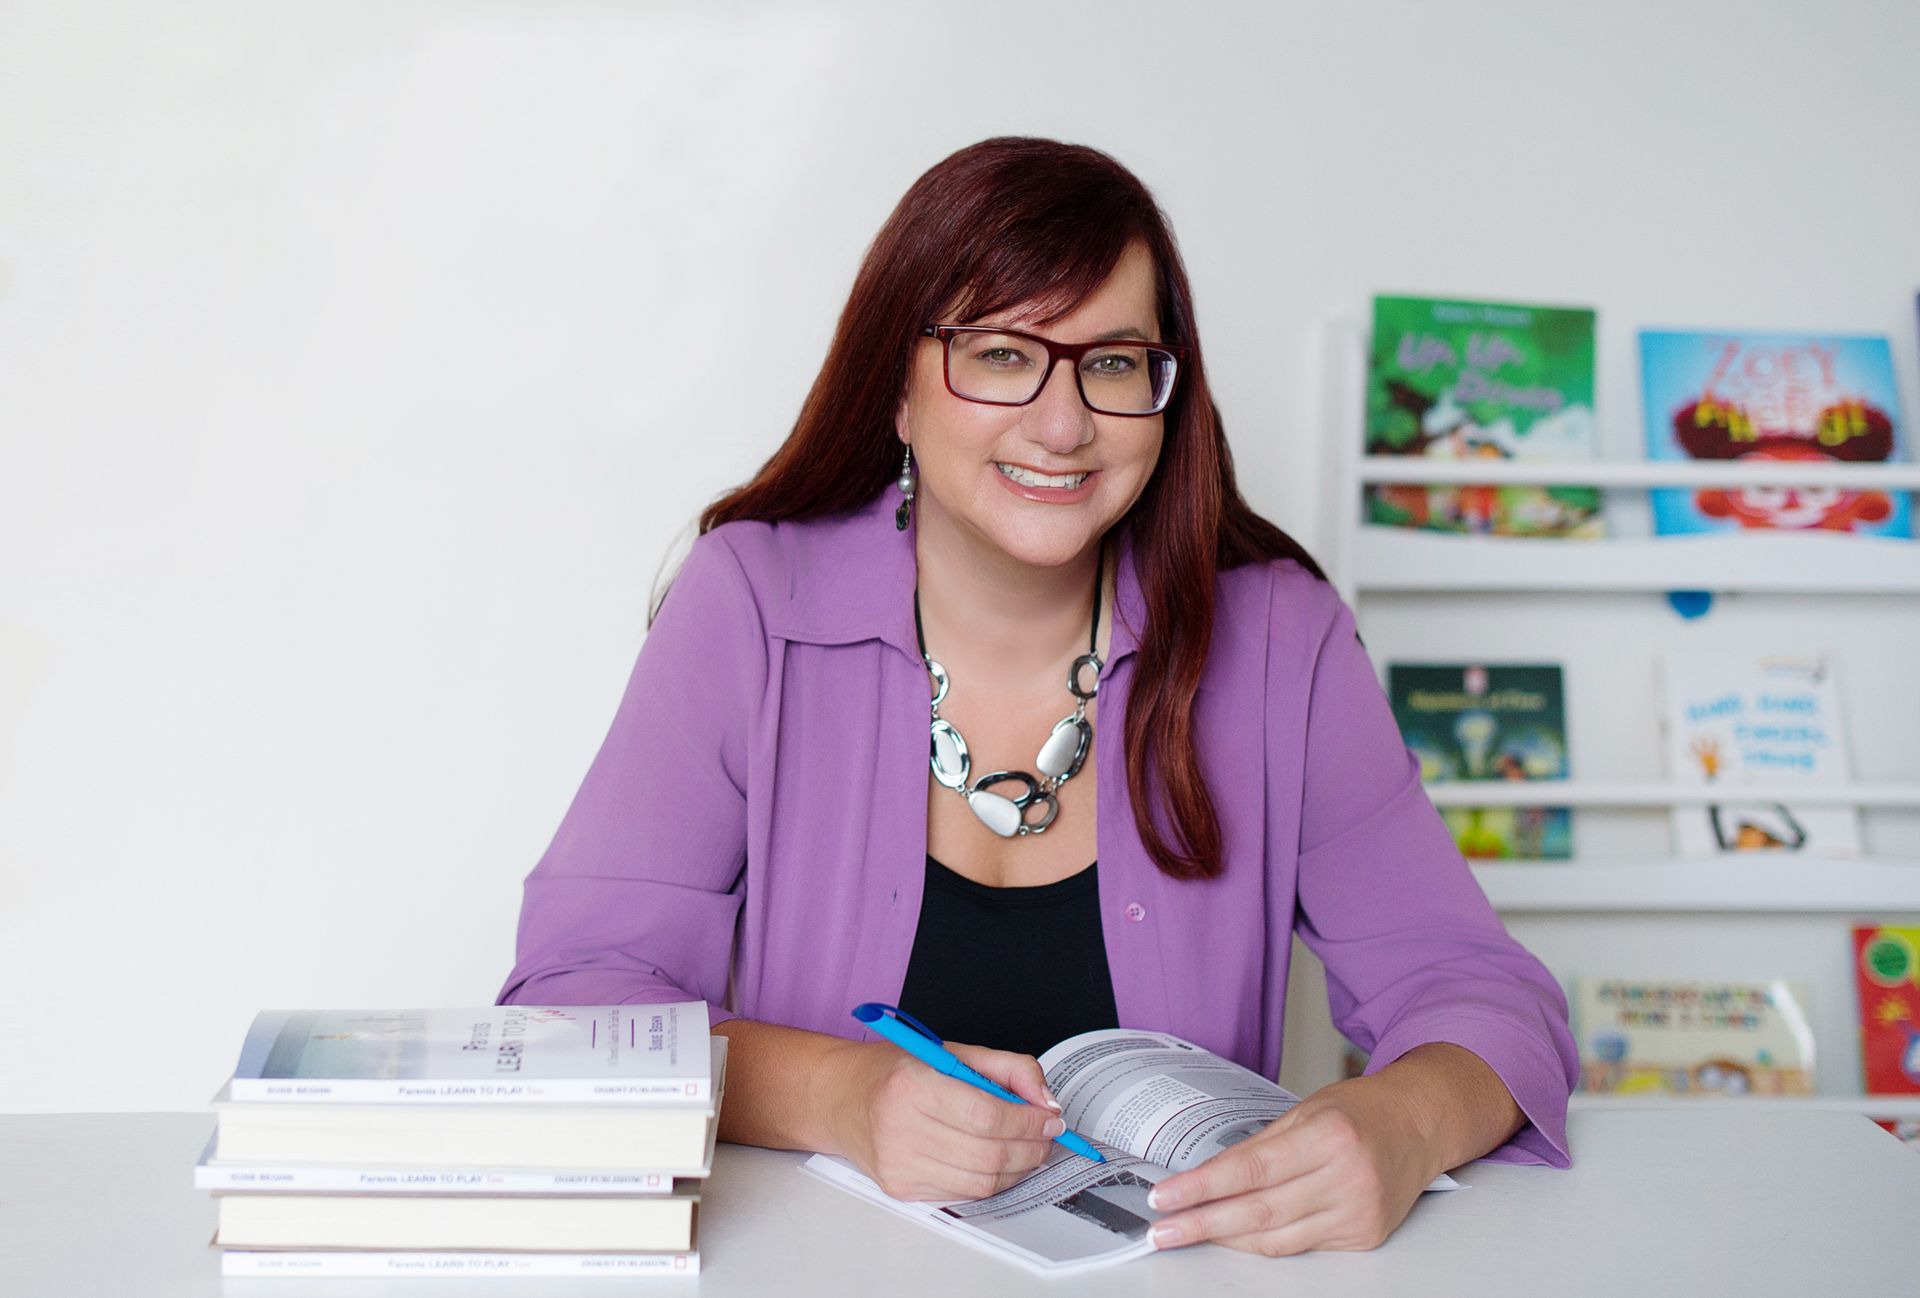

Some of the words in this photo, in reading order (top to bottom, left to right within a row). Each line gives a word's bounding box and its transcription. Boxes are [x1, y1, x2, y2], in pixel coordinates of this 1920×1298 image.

[503, 1009, 528, 1026] PLAY
[462, 1022, 492, 1051] Parents
[501, 1026, 526, 1038] TO
[495, 1039, 524, 1072] LEARN
[398, 1086, 436, 1096] Parents
[440, 1086, 476, 1096] LEARN
[497, 1086, 523, 1096] PLAY
[1180, 1120, 1221, 1160] EXPERIENCES
[400, 1174, 436, 1184] LEARN
[457, 1174, 483, 1184] PLAY
[1062, 1168, 1111, 1195] INTENTIONAL
